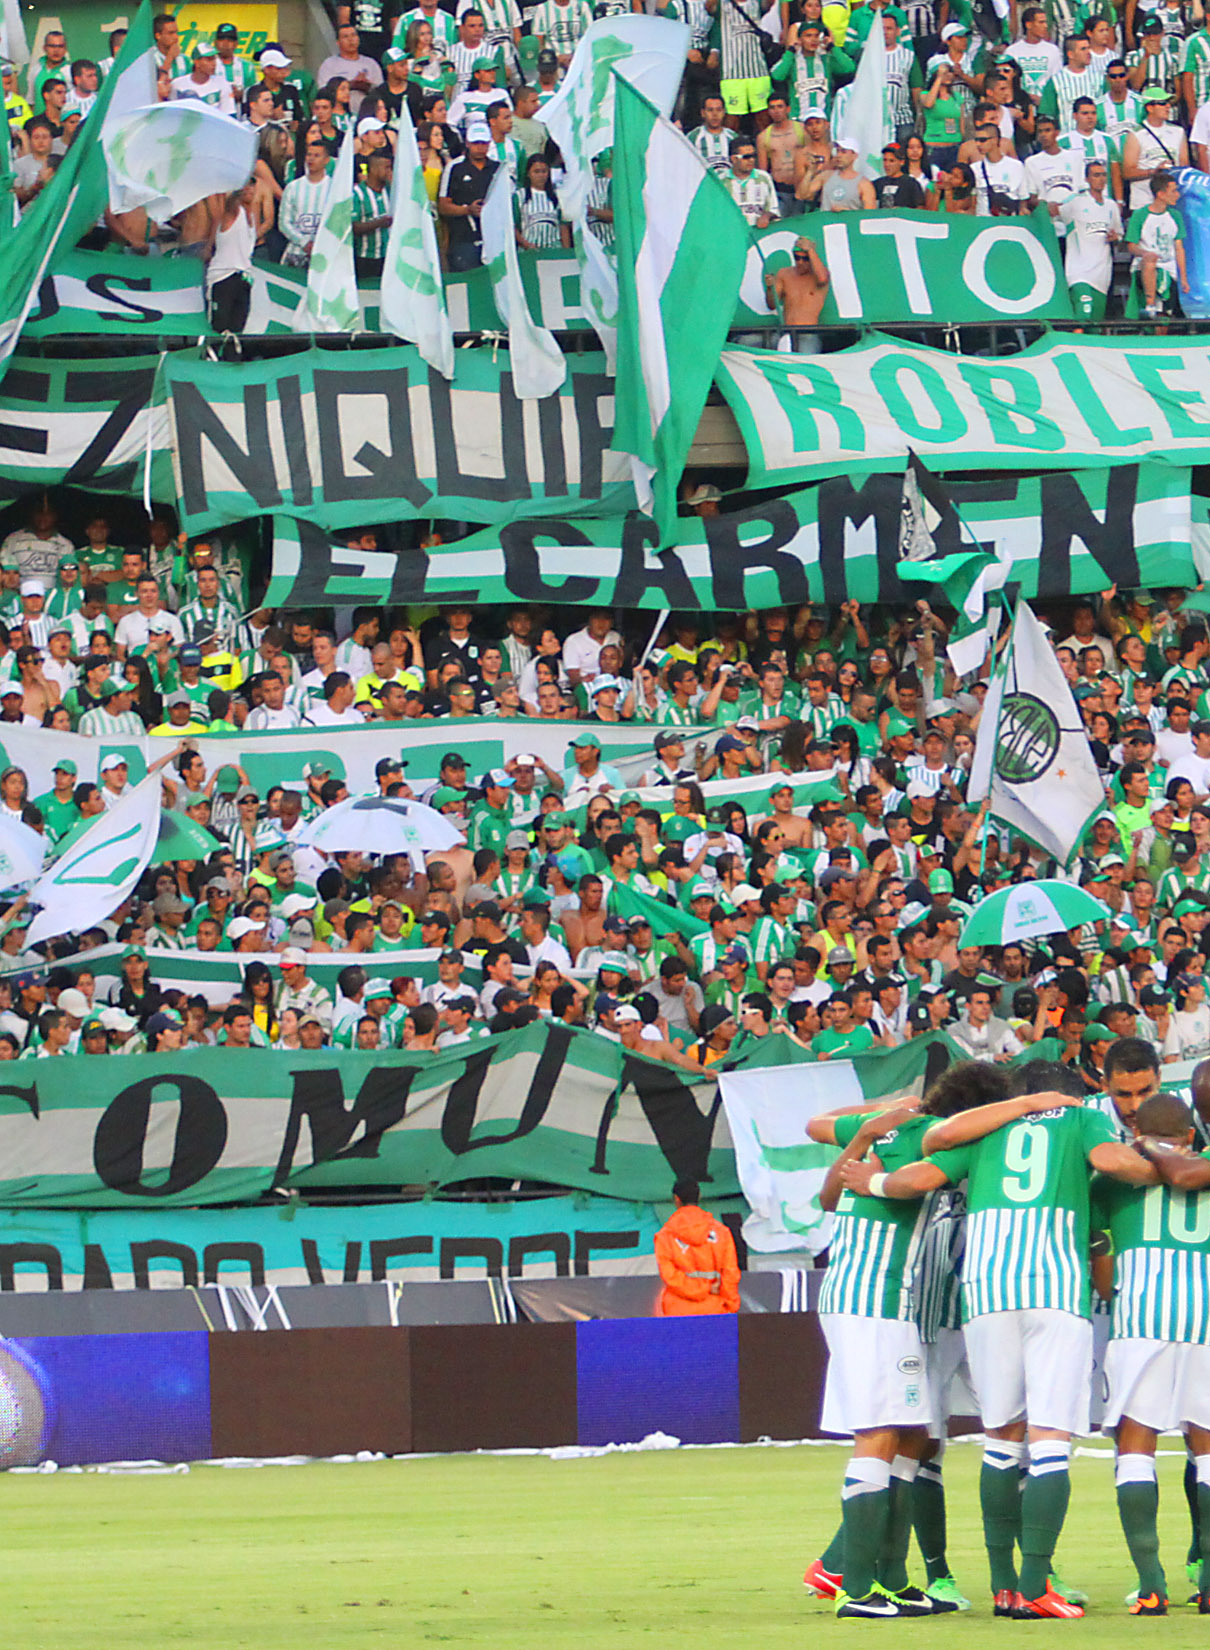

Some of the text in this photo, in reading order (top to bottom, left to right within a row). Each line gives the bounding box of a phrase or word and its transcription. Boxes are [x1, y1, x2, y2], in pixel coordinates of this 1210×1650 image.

[283, 514, 480, 606] EL
[0, 1023, 726, 1196] OMUN
[1002, 1122, 1049, 1202] 9
